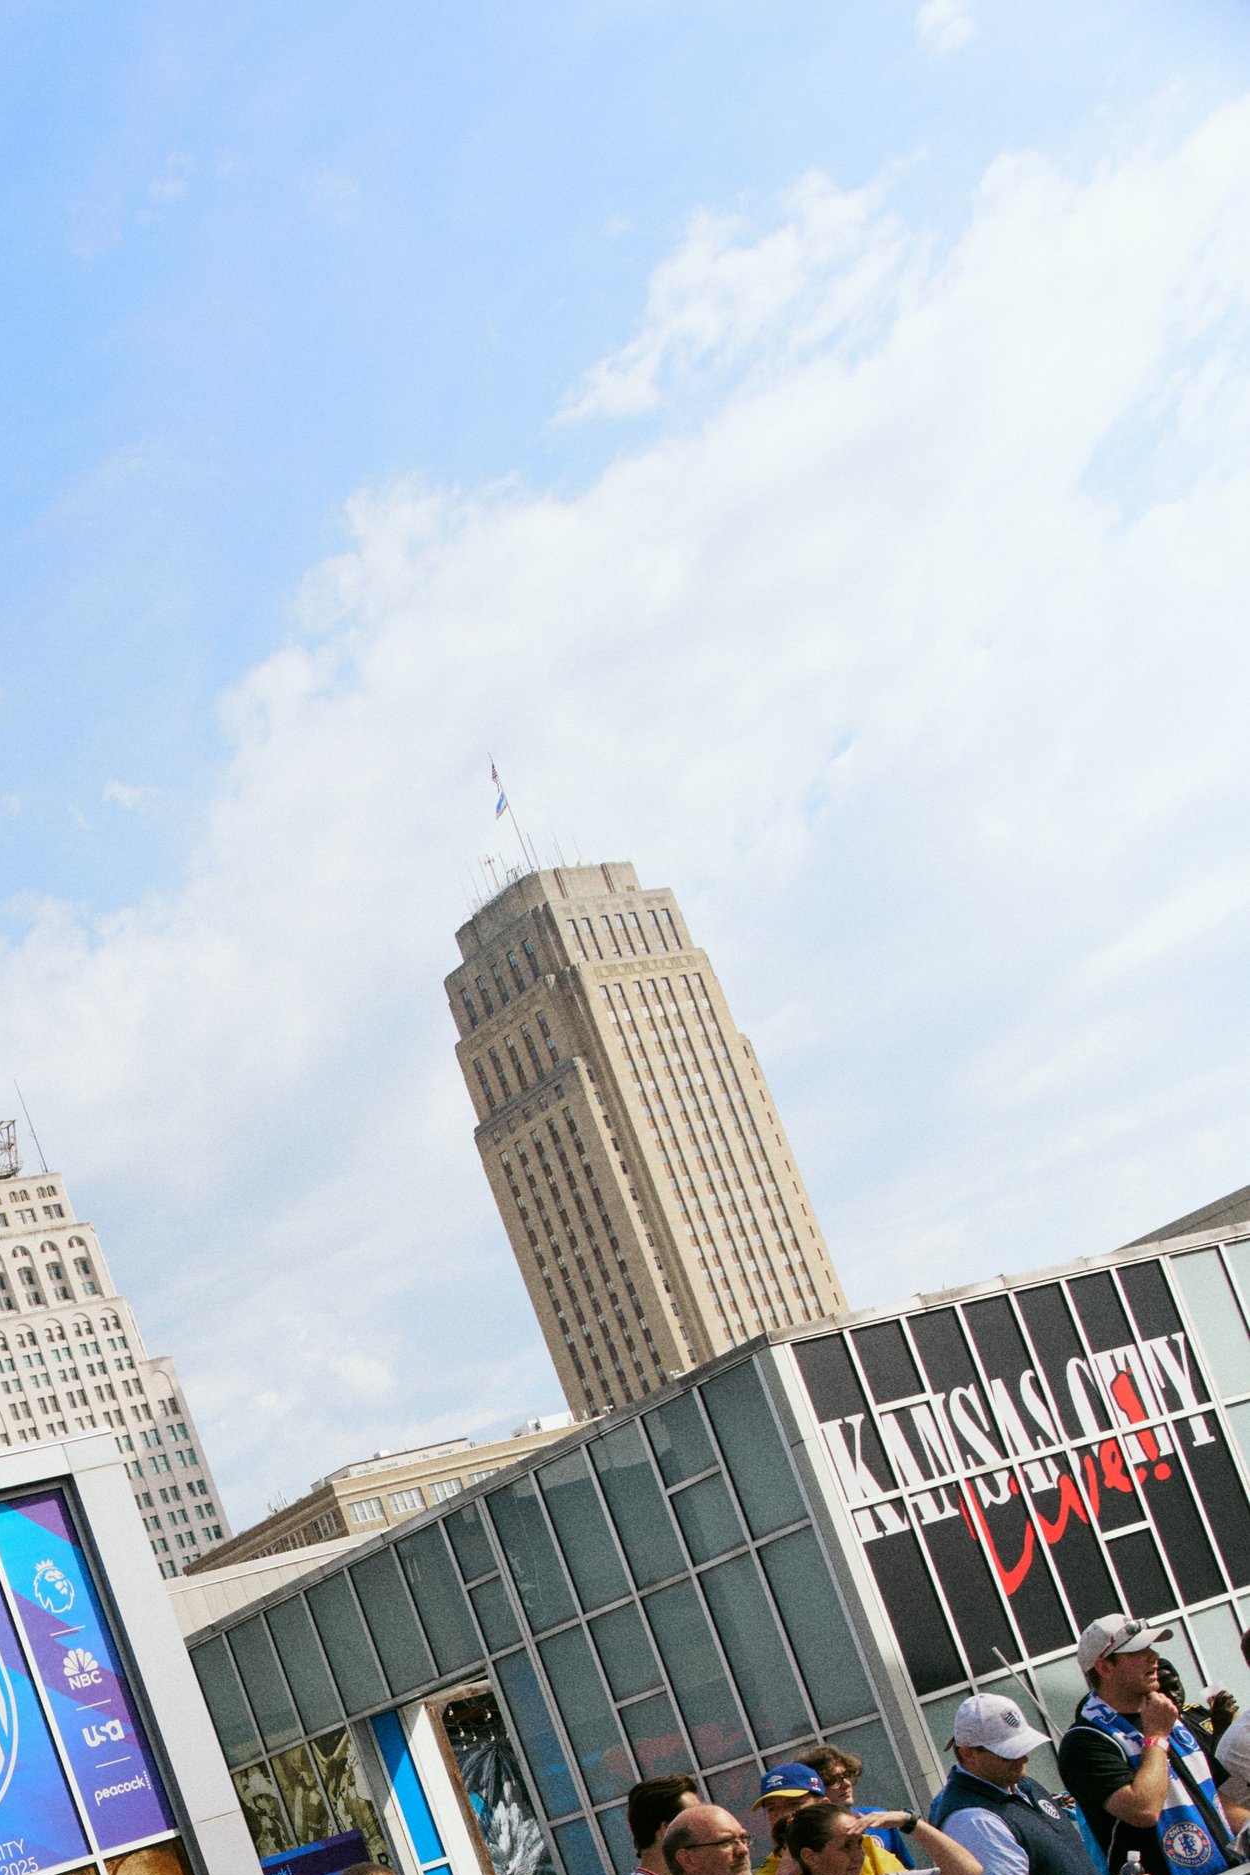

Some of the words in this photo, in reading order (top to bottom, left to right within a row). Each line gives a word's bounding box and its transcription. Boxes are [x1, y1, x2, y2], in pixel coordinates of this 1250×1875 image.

[819, 1369, 1082, 1543] KANSAS
[1066, 1332, 1216, 1466] CITY
[958, 1369, 1172, 1597] Live!
[68, 1671, 102, 1690] NBC
[94, 1774, 146, 1806] peacock
